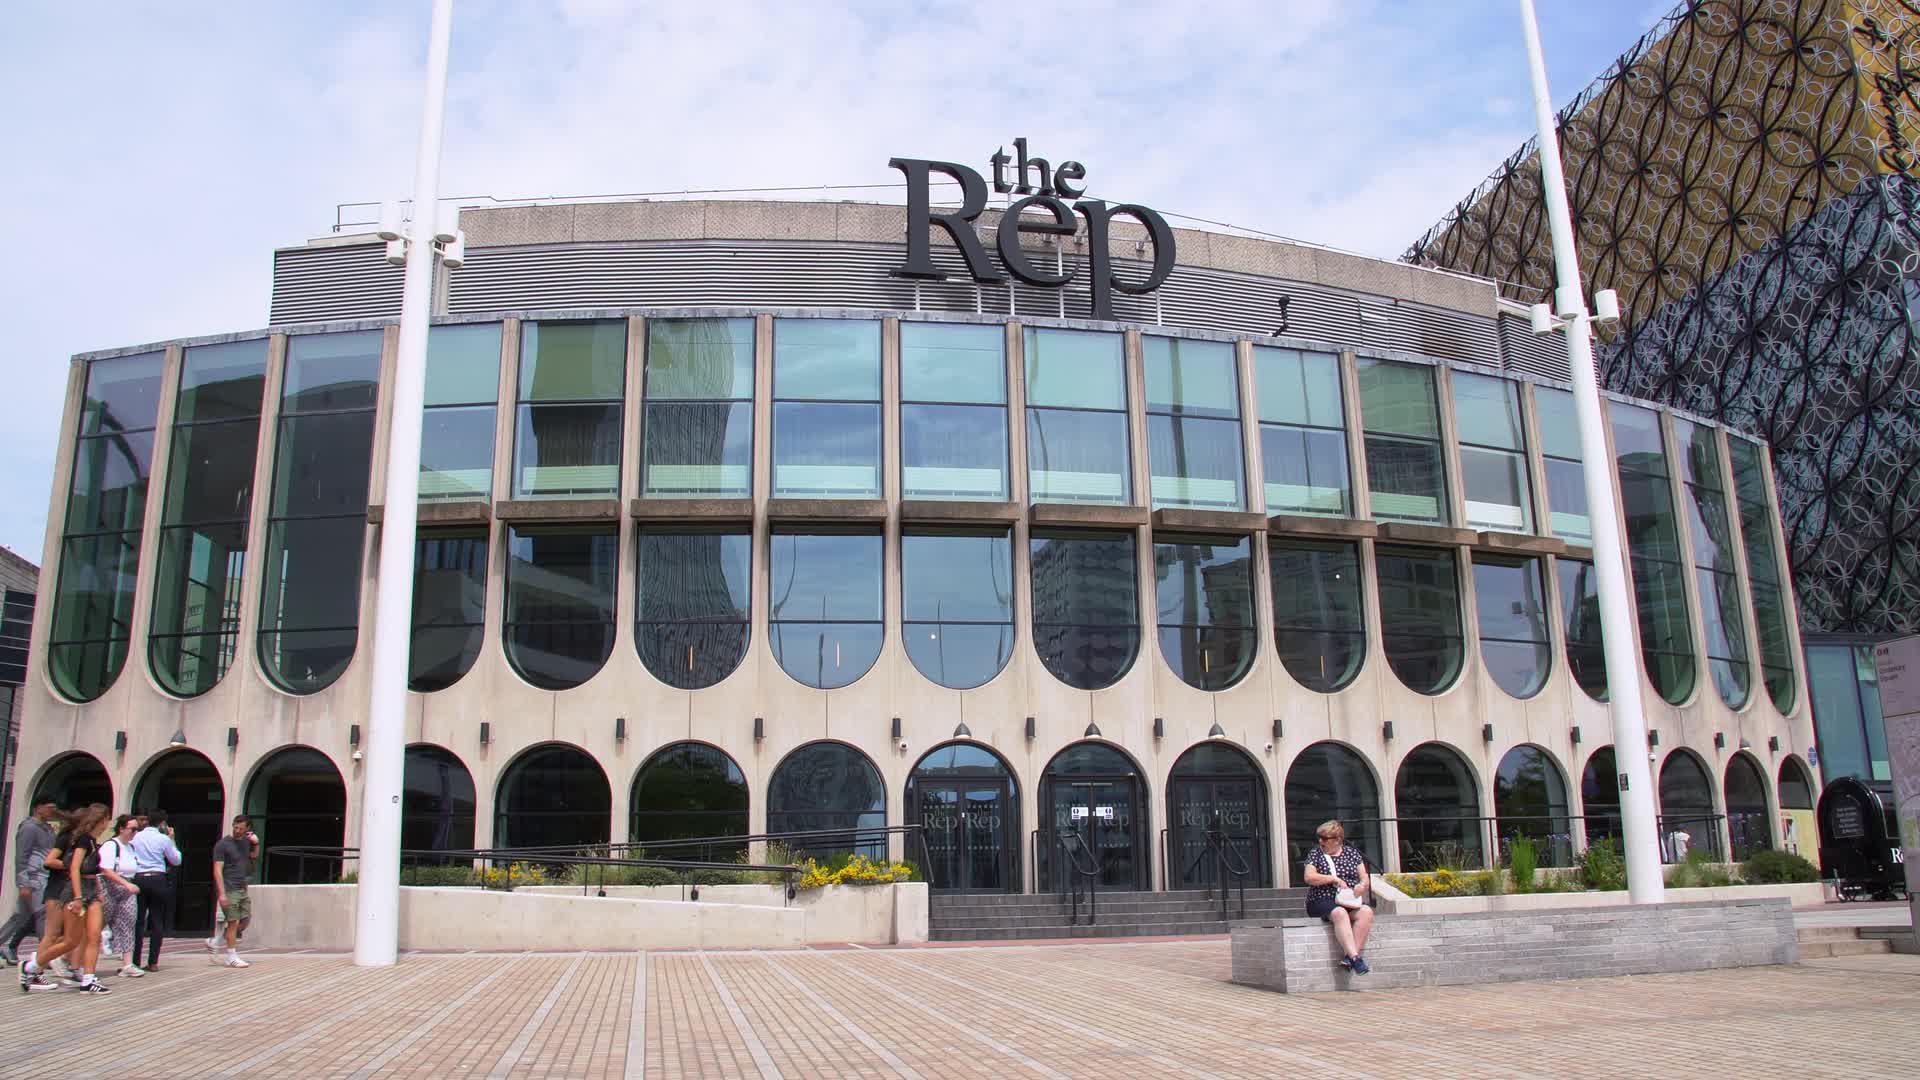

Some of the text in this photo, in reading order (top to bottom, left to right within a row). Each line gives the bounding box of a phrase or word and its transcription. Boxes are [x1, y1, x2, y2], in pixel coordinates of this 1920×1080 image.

[990, 137, 1088, 199] the
[888, 157, 1177, 321] Rep
[924, 812, 958, 832] Rep
[967, 812, 1000, 832] Rep
[1219, 808, 1250, 829] Rep
